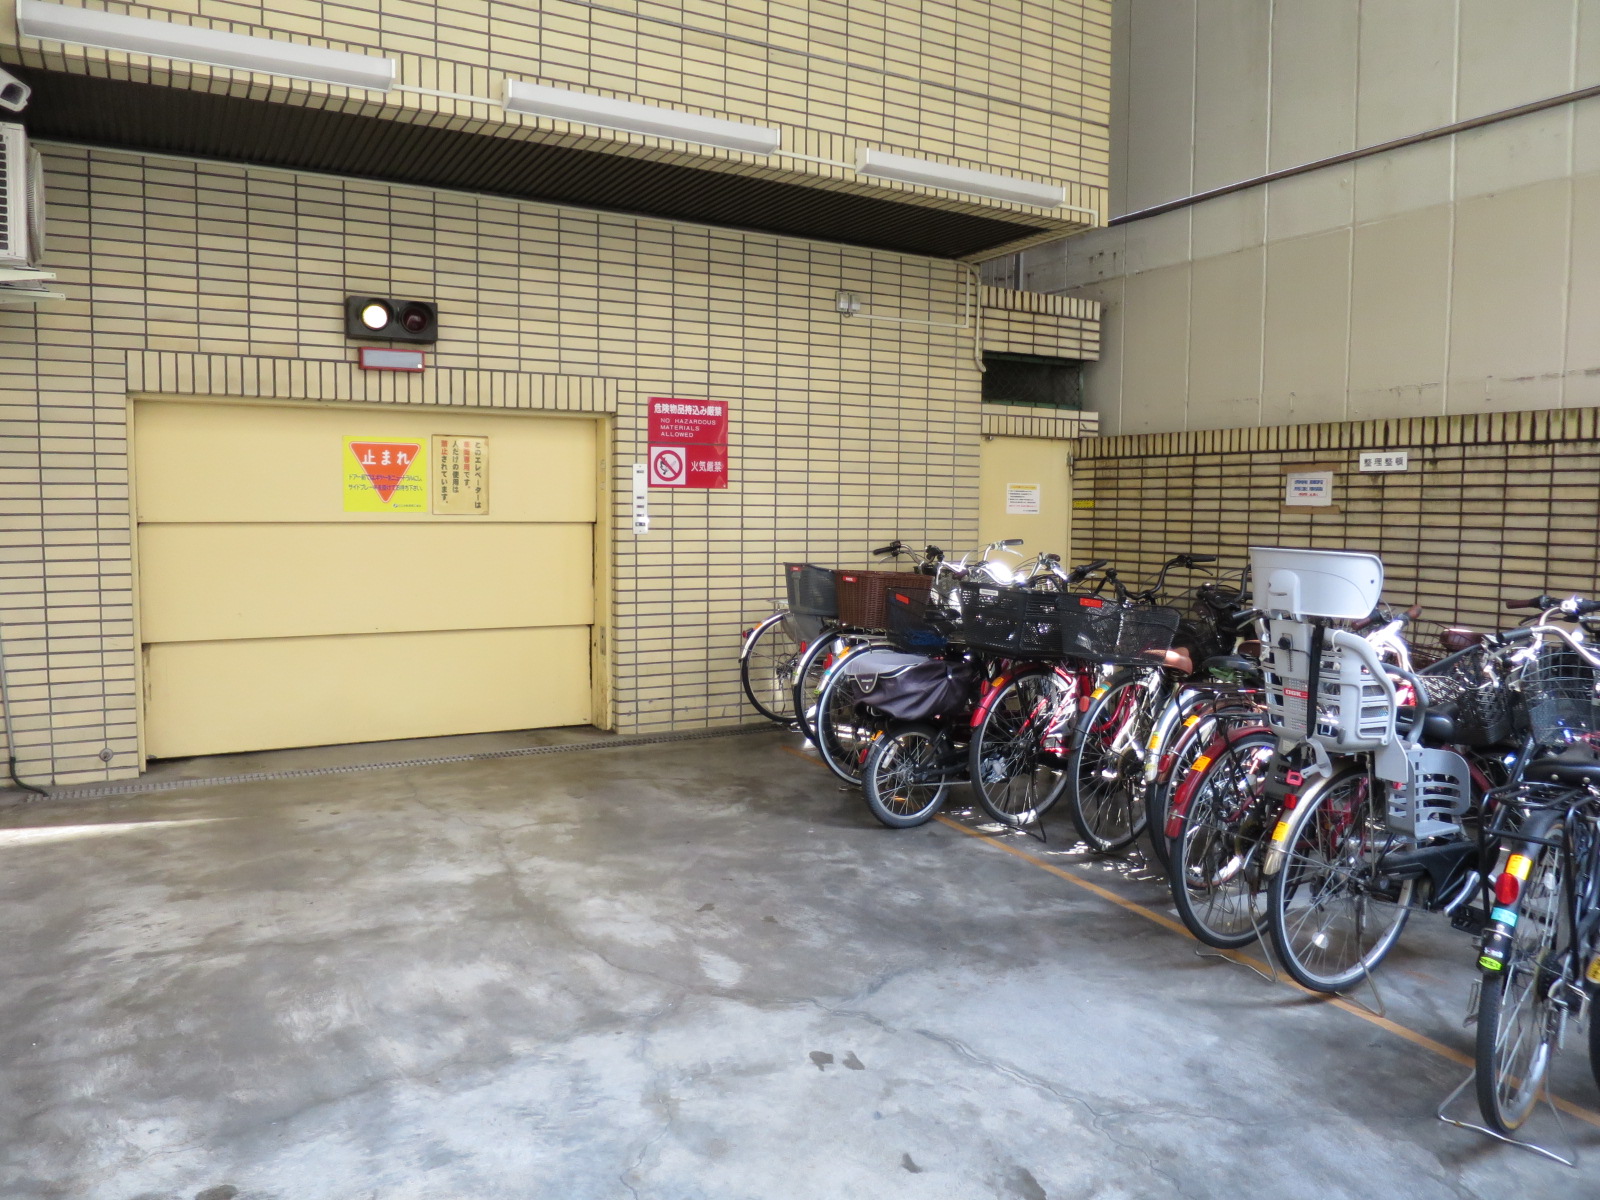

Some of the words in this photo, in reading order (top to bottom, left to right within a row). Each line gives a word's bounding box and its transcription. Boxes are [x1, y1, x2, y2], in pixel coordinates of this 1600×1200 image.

[654, 403, 722, 417] 危険物品持込み厳禁
[675, 418, 716, 426] HAZARDOUS
[361, 448, 412, 466] 止まれ
[1363, 456, 1404, 468] 整理整頓
[440, 440, 449, 504] 禁止されています。
[452, 440, 460, 493] 人だけの使用は
[690, 460, 722, 472] 火気厳禁
[474, 442, 482, 509] このエレベーターは
